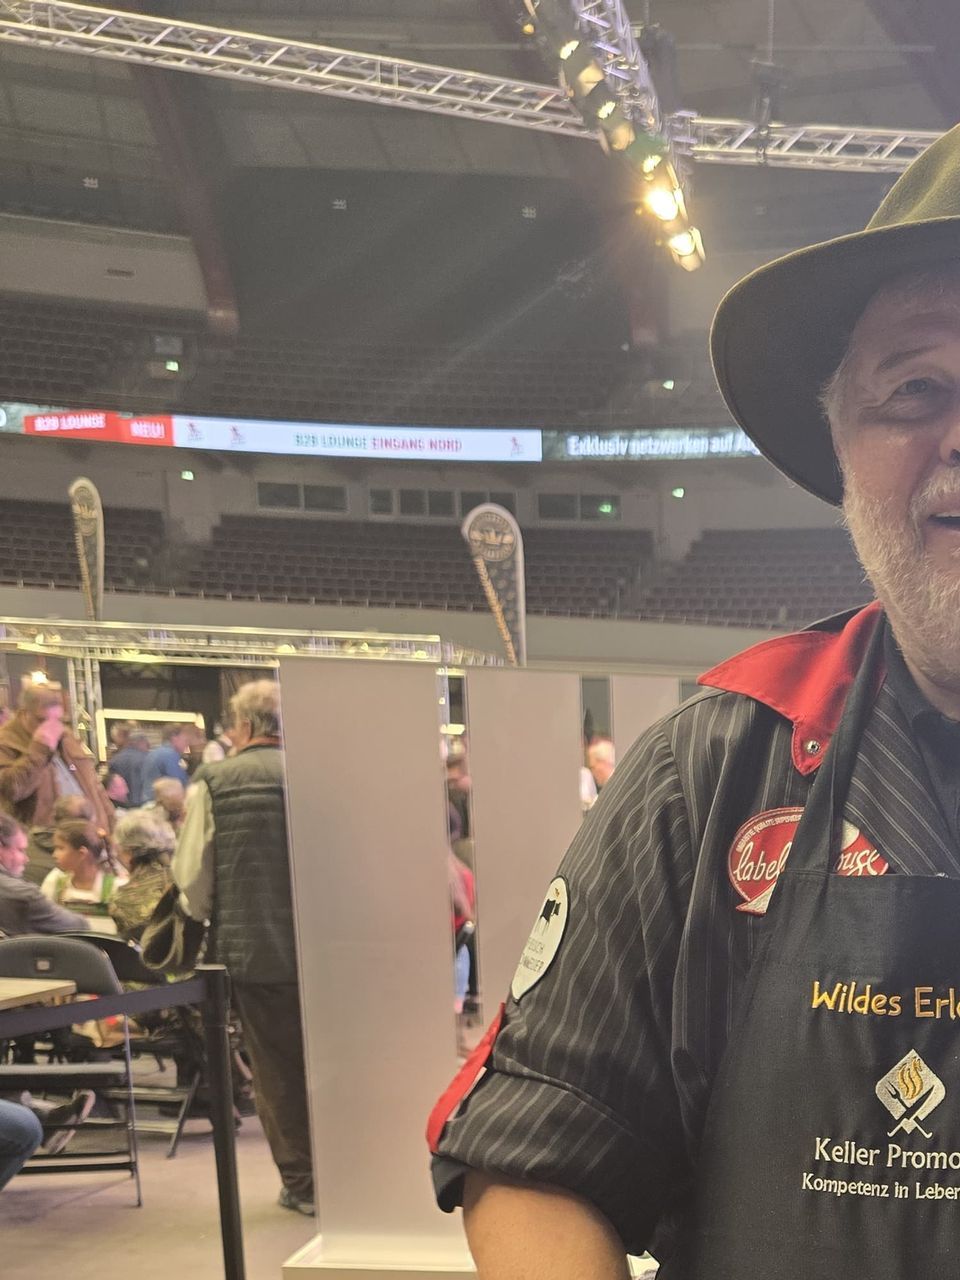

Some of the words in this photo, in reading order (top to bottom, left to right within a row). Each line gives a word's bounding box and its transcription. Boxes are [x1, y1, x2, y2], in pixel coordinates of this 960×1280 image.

[322, 434, 367, 449] LOUNGE
[372, 437, 425, 451] EINGANG
[429, 438, 463, 453] NORD
[567, 434, 628, 455] Exklusiv
[811, 980, 902, 1016] Wildes
[815, 1137, 880, 1166] Keller
[802, 1172, 889, 1198] Kompetenz
[894, 1181, 909, 1199] in
